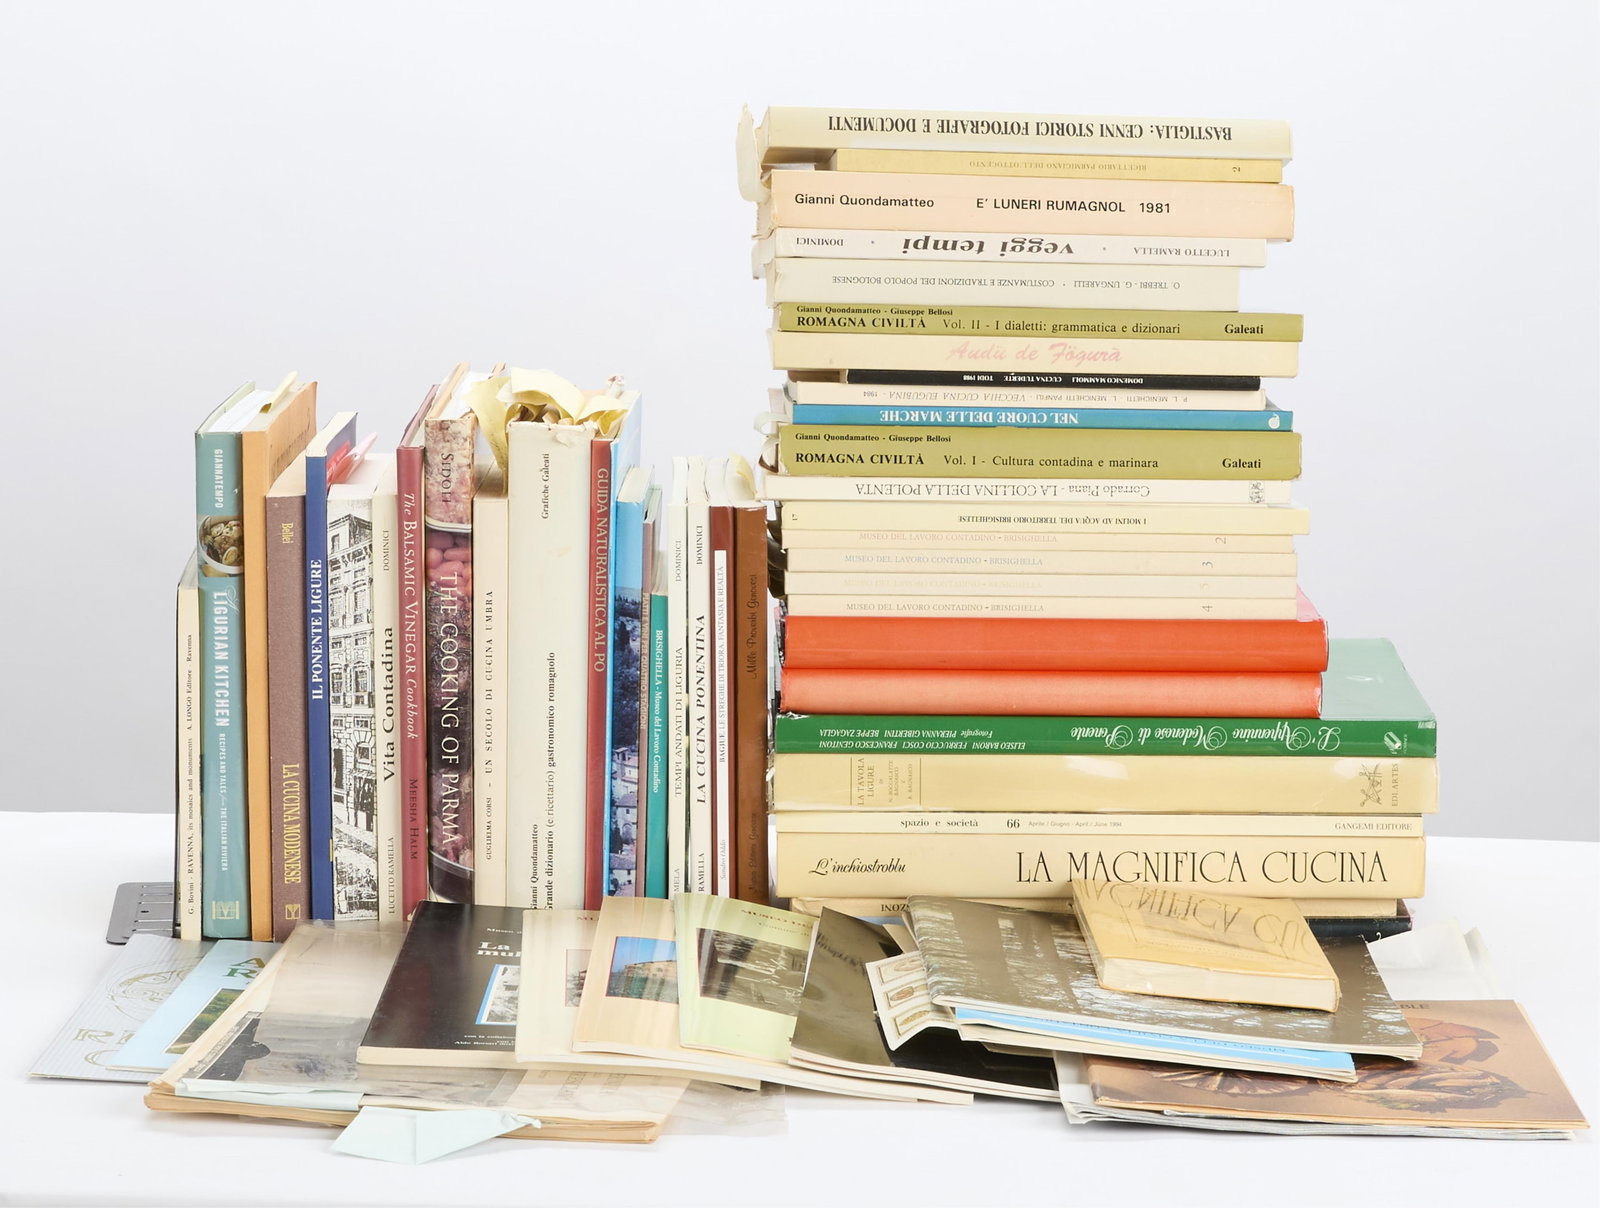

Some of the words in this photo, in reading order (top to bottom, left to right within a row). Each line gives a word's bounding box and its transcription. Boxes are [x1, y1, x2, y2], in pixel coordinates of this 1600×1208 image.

[828, 116, 916, 132] DOCUMENTI
[936, 119, 1029, 135] FOTOGRAFIE
[1036, 122, 1093, 137] STORICI
[1100, 123, 1143, 138] CENNI
[1150, 125, 1231, 140] BASTIGLIA:
[794, 193, 834, 204] Gianni
[839, 194, 934, 207] Quondamatteo
[993, 198, 1041, 210] LUNERI
[1046, 200, 1125, 212] RUMAGNOL
[1139, 202, 1169, 213] 1981
[796, 237, 843, 246] DOMINICI
[902, 235, 984, 254] tempi
[999, 237, 1073, 256] veggi
[1133, 247, 1180, 255] RAMELLA
[832, 275, 881, 284] BOLOGNESE
[883, 276, 917, 284] POPOLO
[938, 277, 987, 286] TRADIZIONI
[997, 279, 1054, 287] COSTUMANZE
[1074, 280, 1120, 288] UNGARELLI
[825, 306, 881, 314] Quondamatteo
[890, 307, 924, 316] Giuseppe
[797, 316, 866, 327] ROMAGNA
[871, 317, 926, 328] CIVILTÀ
[943, 319, 965, 328] Vol.
[1004, 320, 1046, 331] dialetti:
[1051, 322, 1116, 333] grammatica
[1131, 322, 1180, 333] dizionari
[1224, 324, 1263, 334] Galeati
[879, 410, 942, 422] MARCHE
[946, 411, 992, 422] DELLE
[996, 412, 1047, 423] CUORE
[1049, 412, 1078, 424] NEL
[541, 453, 549, 482] Galeati
[795, 452, 864, 463] ROMAGNA
[870, 452, 924, 464] CIVILTÀ
[992, 455, 1034, 466] Cultura
[1038, 456, 1093, 466] contadina
[1109, 457, 1158, 468] marinara
[1222, 458, 1261, 468] Galeati
[214, 448, 224, 508] GIANNATEMPO
[441, 453, 453, 502] SIDOLI
[596, 468, 608, 512] GUIDA
[855, 483, 920, 495] POLENTA
[925, 484, 970, 495] DELLA
[974, 484, 1037, 496] COLLINA
[1068, 485, 1099, 496] Piana
[1102, 485, 1150, 497] Corrado
[404, 493, 415, 515] The
[541, 484, 549, 519] Grafiche
[281, 522, 294, 543] Bellei
[1215, 536, 1226, 544] 2
[403, 520, 417, 596] BALSAMIC
[594, 517, 607, 626] NATURALISTICA
[310, 559, 322, 613] LIGURE
[440, 571, 457, 614] THE
[212, 591, 228, 659] LIGURIAN
[404, 600, 418, 674] VINEGAR
[311, 616, 322, 682] PONENTE
[655, 630, 663, 685] BRISIGHELLA
[593, 653, 605, 672] PO
[695, 615, 705, 708] PONENTINA
[381, 628, 394, 733] Contadina
[440, 623, 458, 727] COOKING
[546, 652, 556, 701] romagnolo
[214, 665, 230, 726] KITCHEN
[311, 685, 323, 699] IL
[654, 691, 662, 714] Museo
[406, 678, 418, 739] Cookbook
[546, 705, 556, 767] gastronomico
[653, 728, 661, 753] Lavoro
[696, 715, 705, 776] CUCINA
[818, 740, 854, 748] GENITONI
[854, 740, 897, 748] FRANCESCO
[902, 741, 924, 749] COSCI
[925, 741, 967, 749] FERRUCCIO
[972, 741, 999, 750] BARONI
[1000, 741, 1025, 750] ELISEO
[1070, 724, 1133, 749] Ponente
[1154, 725, 1227, 750] Modenese
[1232, 722, 1341, 751] L'Appennino
[441, 736, 459, 763] OF
[282, 763, 300, 778] LA
[383, 742, 394, 781] Vita
[652, 754, 661, 792] Contadino
[856, 757, 864, 792] TAVOLA
[282, 780, 300, 822] CUCINA
[409, 778, 418, 822] MEESHA
[545, 770, 555, 815] ricettario)
[696, 784, 705, 803] LA
[441, 772, 458, 842] PARMA
[900, 818, 929, 828] spazio
[946, 818, 978, 827] società
[1006, 818, 1020, 829] 66
[283, 823, 301, 884] MODENESE
[409, 827, 419, 859] HALM
[530, 824, 539, 883] Quondamatteo
[544, 830, 553, 876] dizionario
[808, 857, 906, 876] L'inchiostroblu
[1016, 850, 1053, 883] LA
[1067, 850, 1246, 882] MAGNIFICA
[1261, 850, 1387, 883] CUCINA
